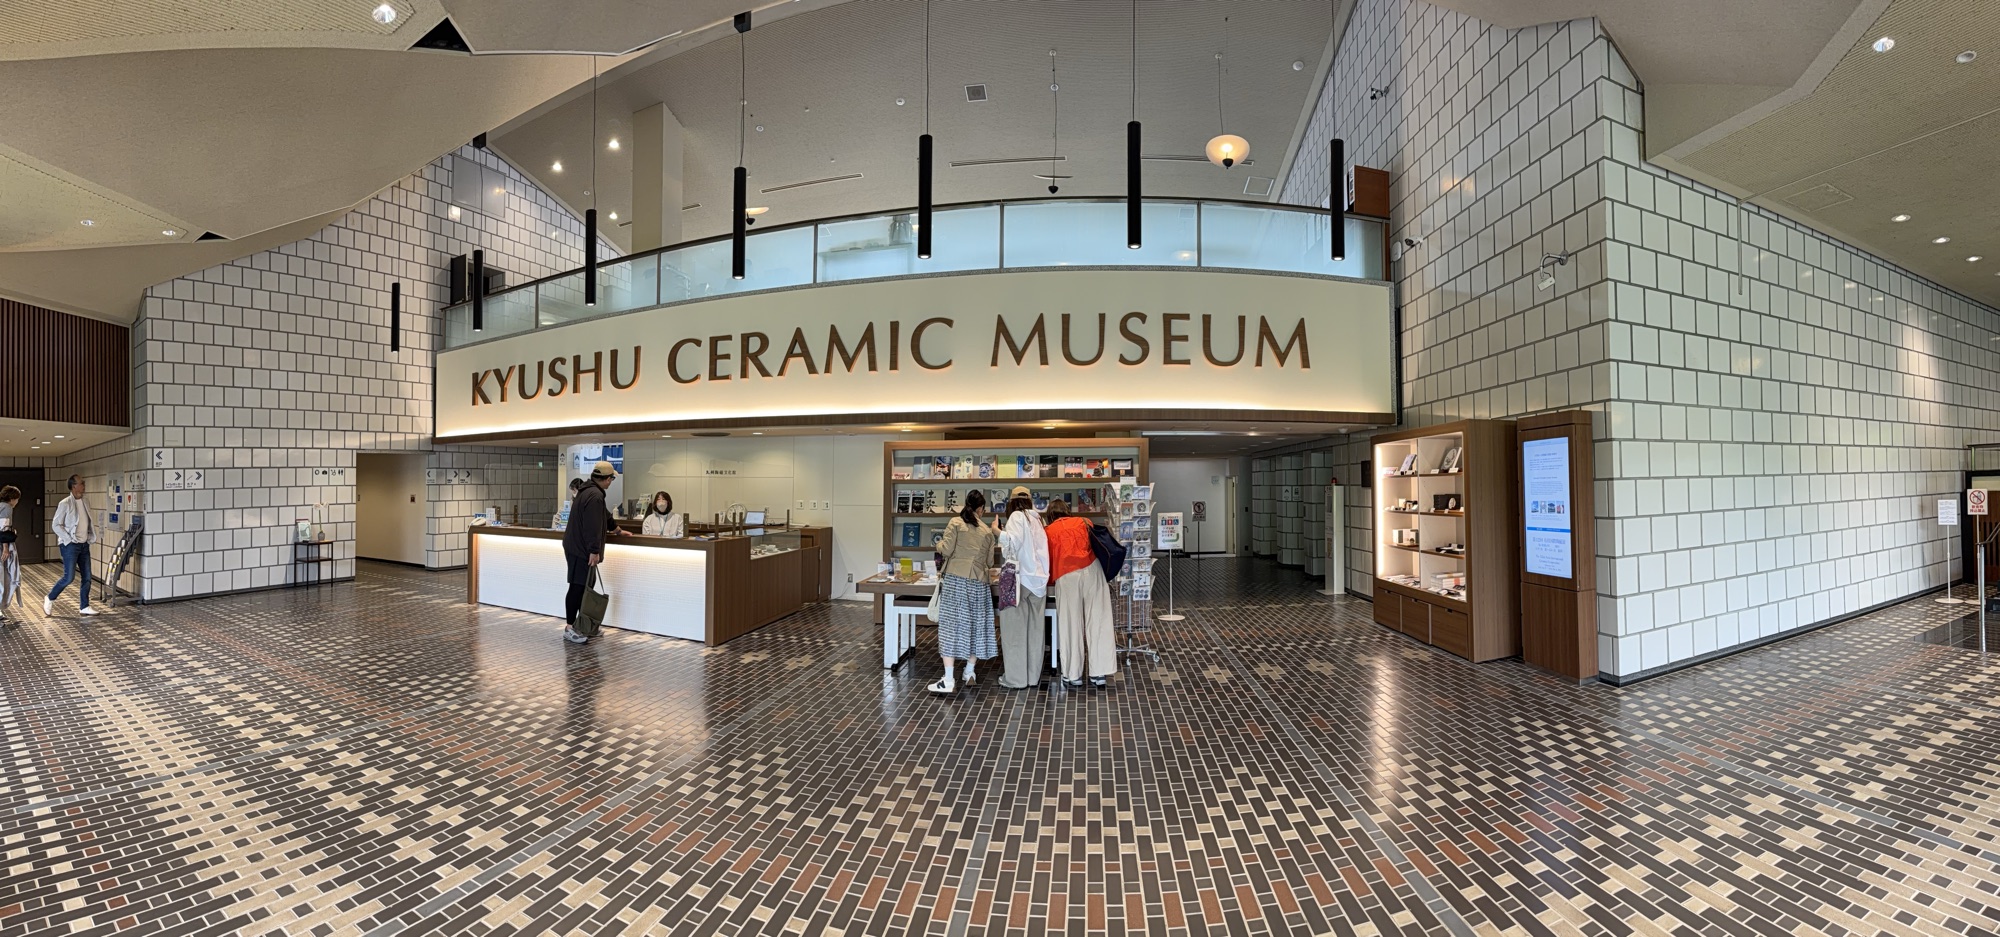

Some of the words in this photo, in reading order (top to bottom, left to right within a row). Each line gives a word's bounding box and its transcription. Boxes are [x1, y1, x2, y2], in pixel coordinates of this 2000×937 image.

[471, 345, 642, 407] KYUSHU
[666, 316, 955, 385] CERAMIC
[989, 311, 1311, 369] MUSEUM
